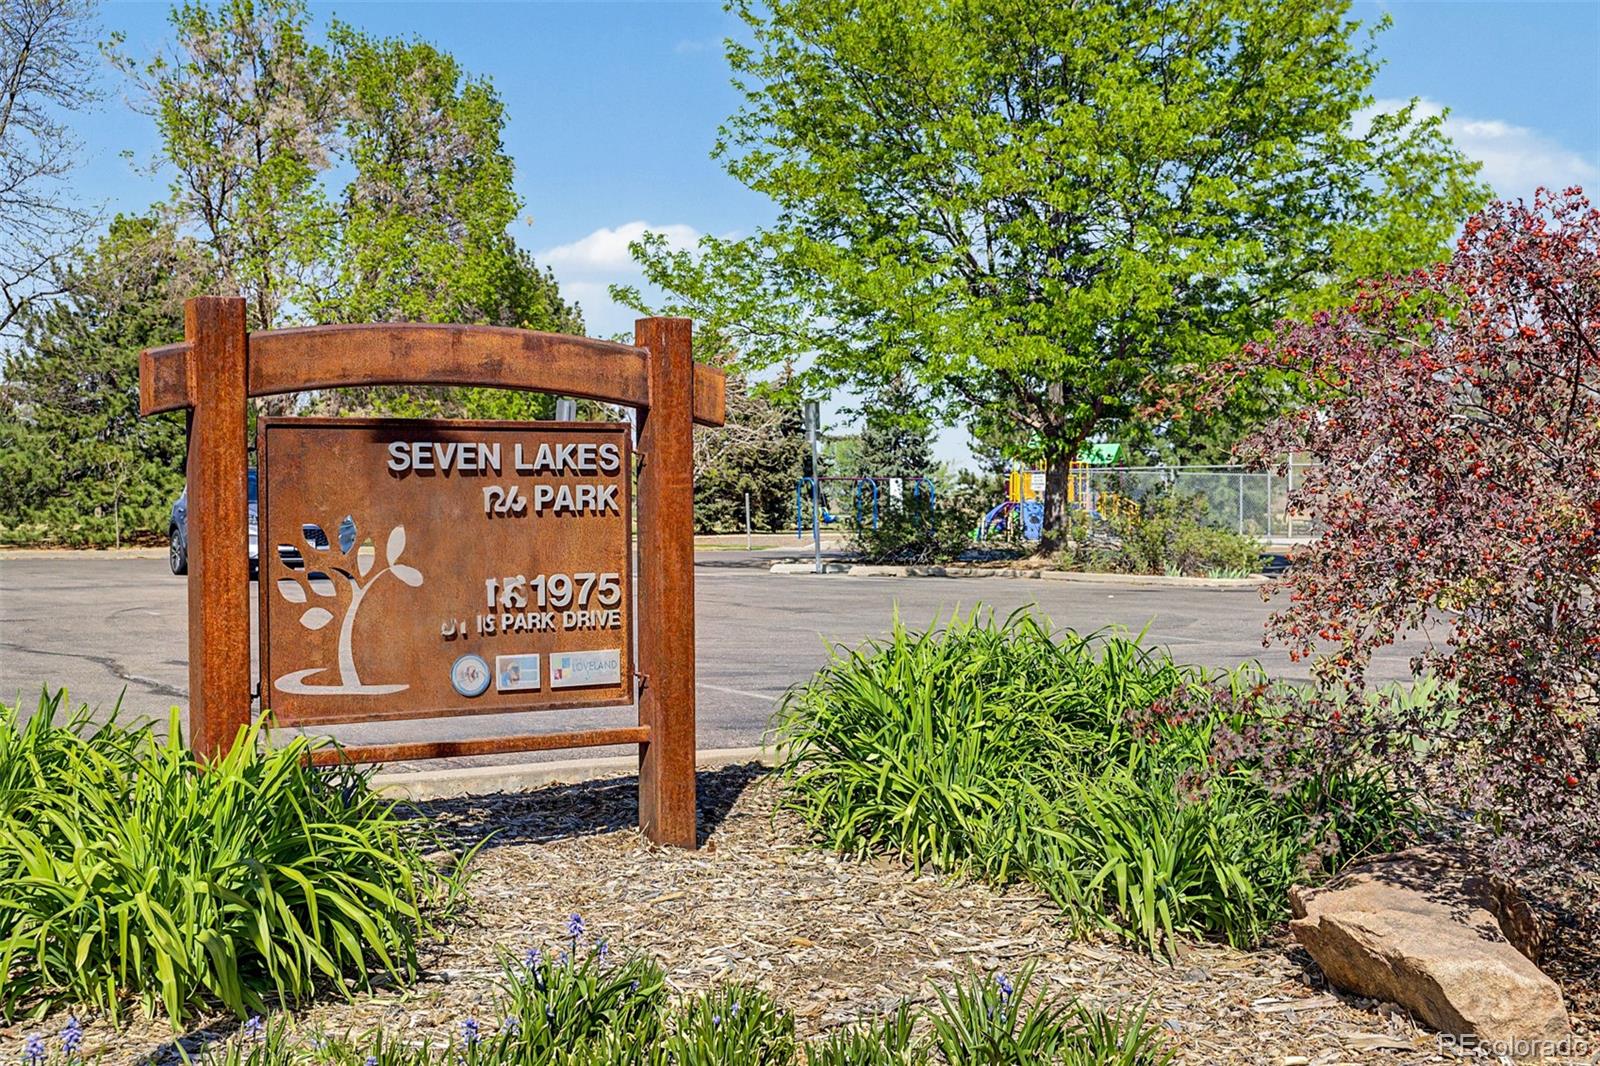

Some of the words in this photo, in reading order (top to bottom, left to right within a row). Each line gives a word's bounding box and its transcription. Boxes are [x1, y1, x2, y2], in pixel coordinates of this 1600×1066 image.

[387, 441, 501, 472] SEVEN
[515, 443, 621, 471] LAKES
[534, 484, 619, 512] PARK
[530, 572, 622, 608] 1975
[501, 613, 555, 631] PARK
[562, 609, 621, 629] DRIVE
[571, 659, 618, 672] LOVELAND
